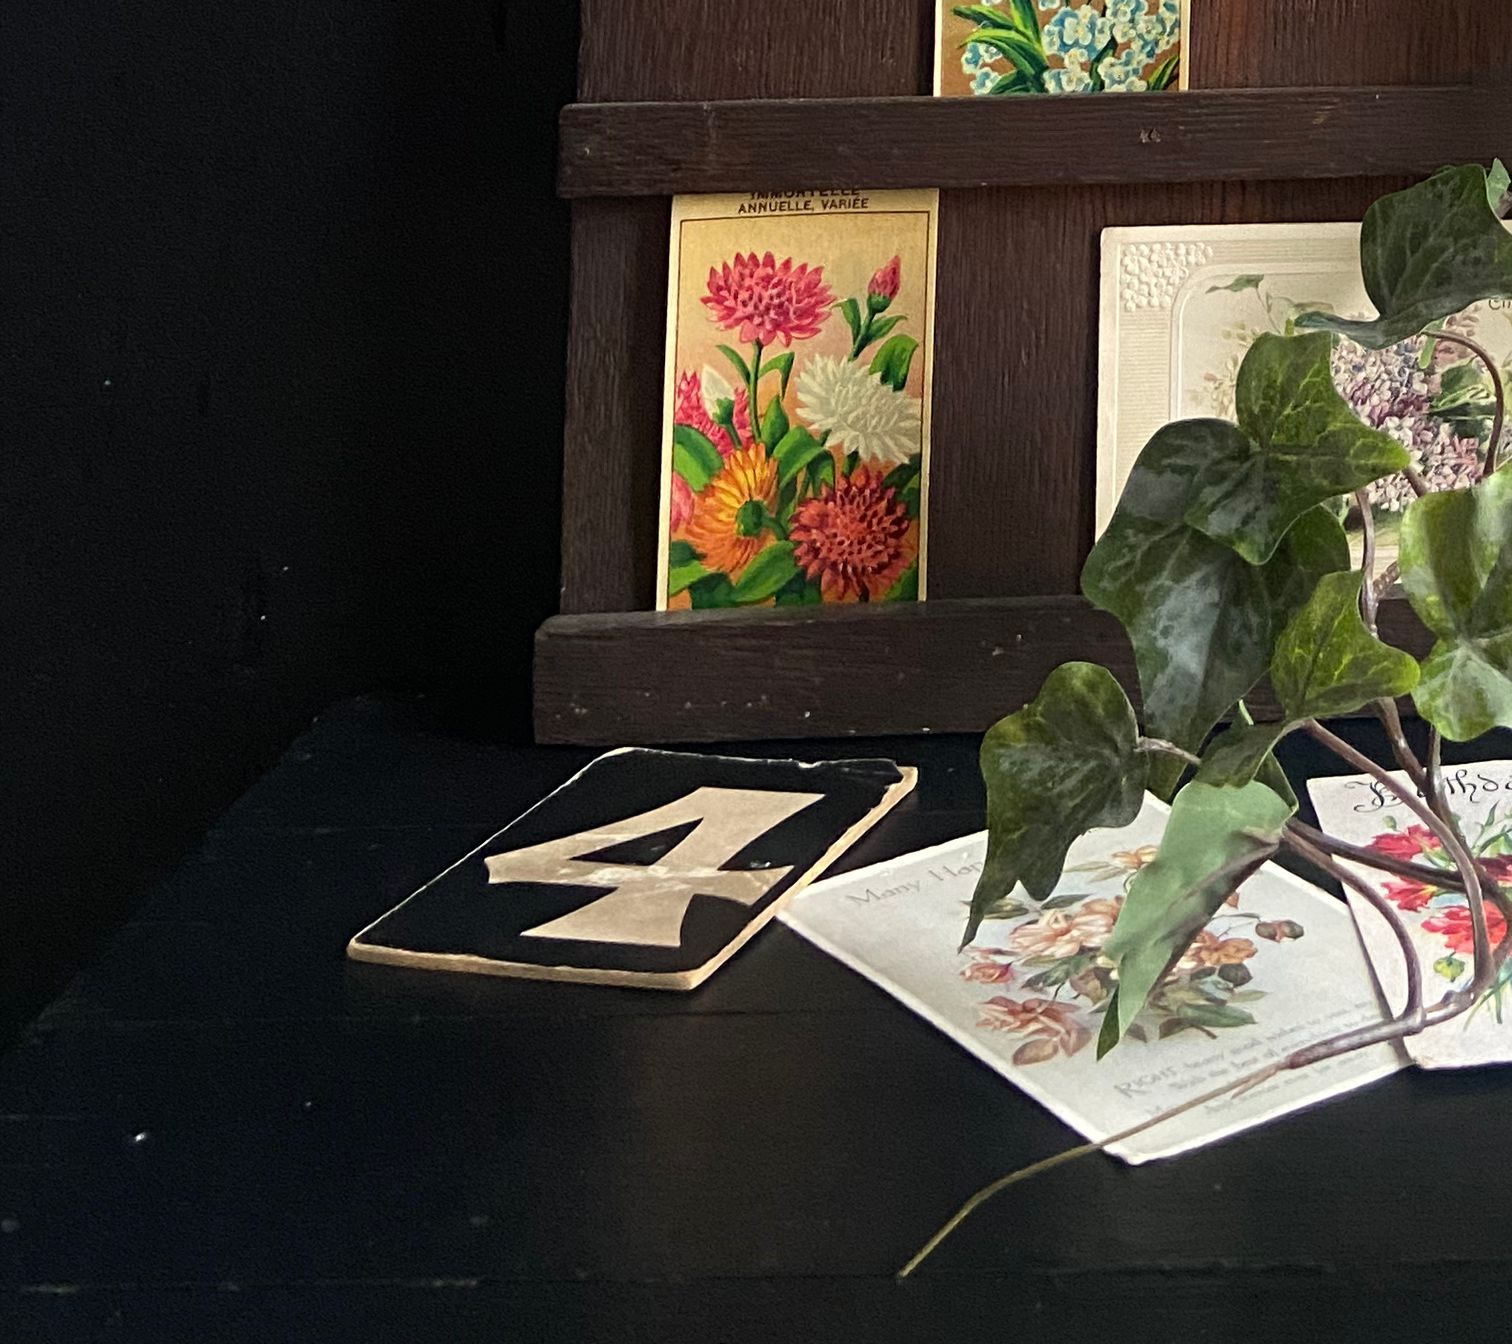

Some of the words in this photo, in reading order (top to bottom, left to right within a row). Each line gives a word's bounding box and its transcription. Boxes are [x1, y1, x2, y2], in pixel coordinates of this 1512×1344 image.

[821, 196, 870, 210] VARIÉE
[485, 787, 825, 947] 4
[845, 879, 922, 904] Many
